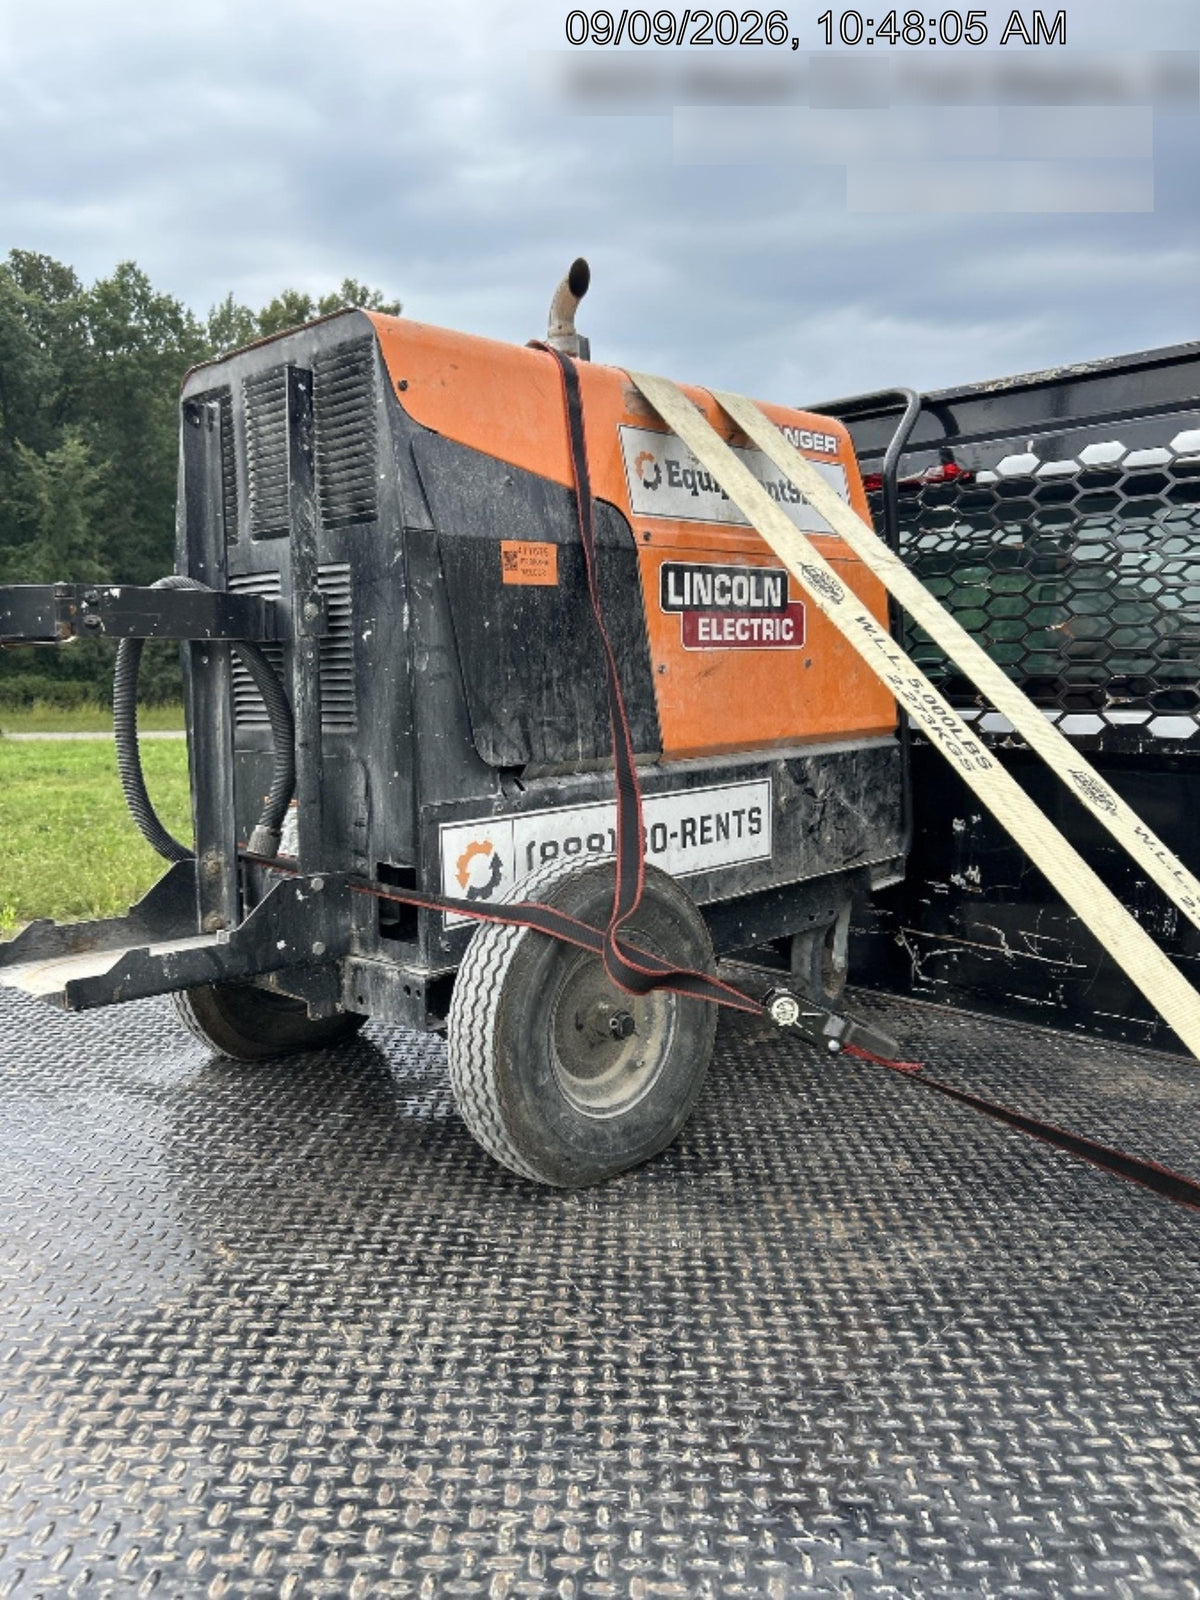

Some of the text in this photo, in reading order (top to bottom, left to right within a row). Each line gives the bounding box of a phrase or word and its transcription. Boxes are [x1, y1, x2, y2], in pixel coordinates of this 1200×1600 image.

[779, 425, 839, 455] NGER
[667, 571, 782, 608] LINCOLN
[697, 617, 795, 642] ELECTRIC
[643, 806, 762, 854] 0-RENTS
